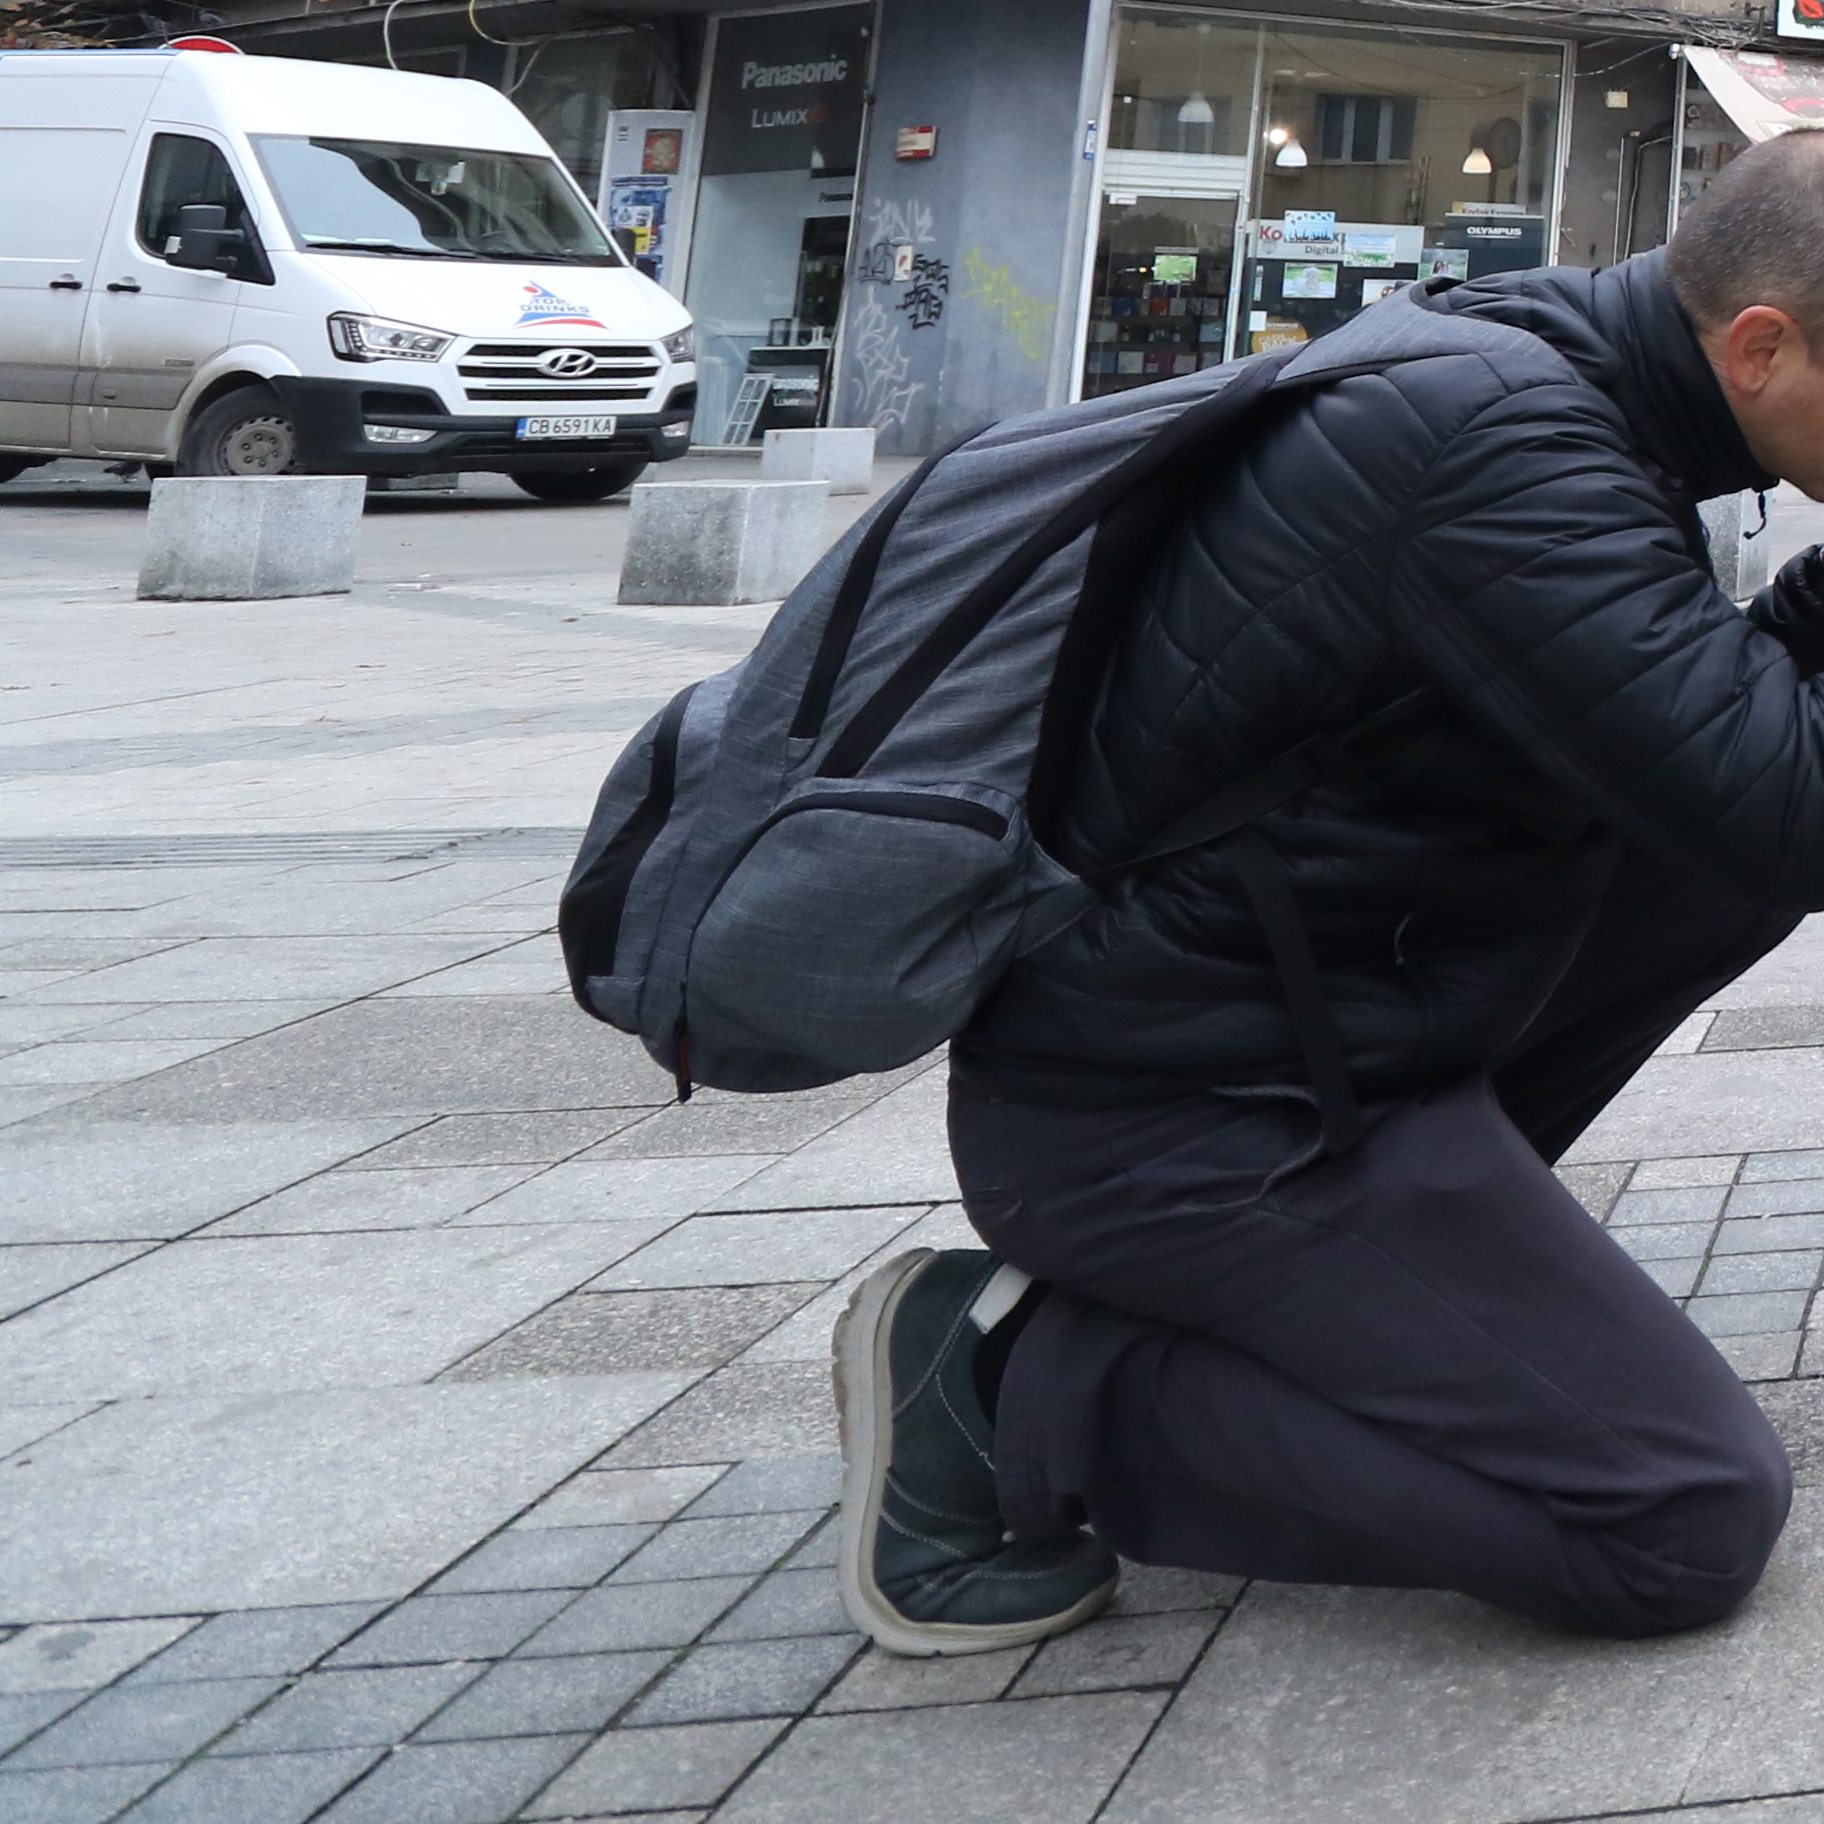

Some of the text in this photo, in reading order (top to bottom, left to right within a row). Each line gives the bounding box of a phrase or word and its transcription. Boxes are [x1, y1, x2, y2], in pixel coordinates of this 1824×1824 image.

[741, 53, 848, 89] Panasonic
[1466, 226, 1523, 236] OLYMPUS
[1305, 245, 1338, 255] Digital
[520, 304, 590, 313] DRINKS
